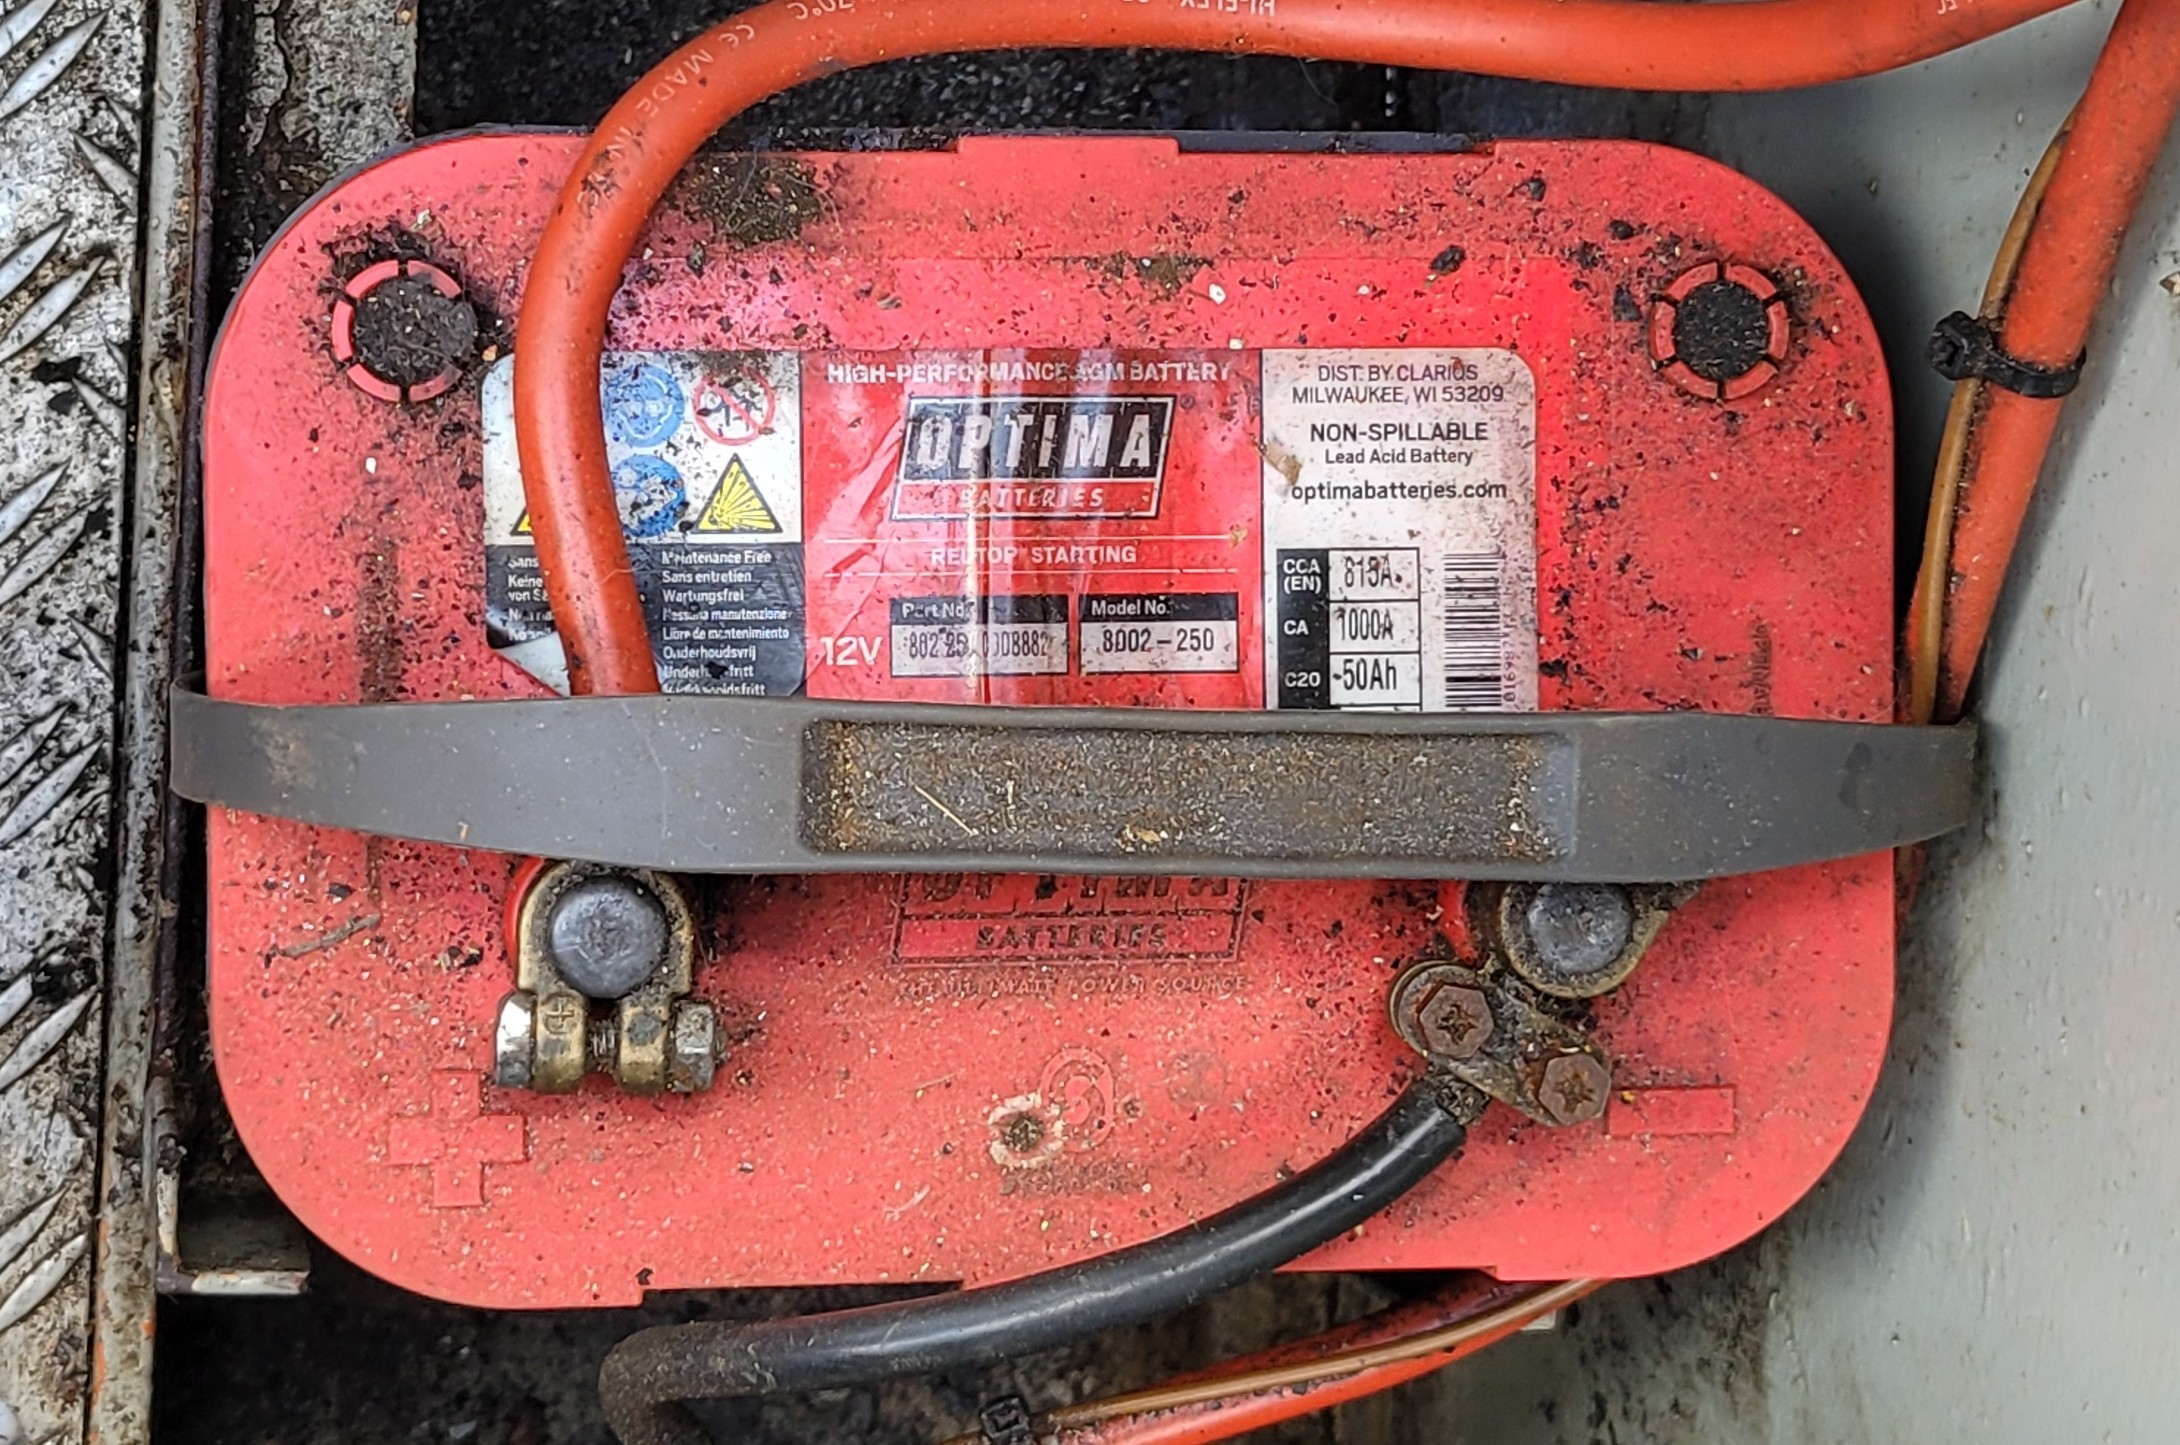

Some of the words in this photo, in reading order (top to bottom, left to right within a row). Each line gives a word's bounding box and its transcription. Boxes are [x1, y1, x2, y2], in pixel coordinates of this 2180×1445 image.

[636, 48, 715, 118] MADE
[827, 361, 1069, 384] HIGH-PERFORMANCE
[1129, 360, 1231, 382] BATTERY
[1367, 364, 1394, 381] BY
[1396, 363, 1479, 382] CLARIOS
[1292, 387, 1411, 405] MILWAUKEE,
[1413, 386, 1437, 403] WI
[1441, 385, 1505, 403] 53209
[916, 413, 1152, 471] OPTIMA
[1310, 422, 1489, 443] NON-SPILLABLE
[1325, 449, 1366, 465] Lead
[1370, 449, 1407, 464] Acid
[1410, 448, 1474, 467] Battery
[957, 487, 1105, 509] BATTERIES
[1291, 479, 1508, 505] optimabatteries.com
[744, 550, 773, 564] Free
[1031, 545, 1137, 564] STARTING
[1282, 558, 1322, 574] CCA
[508, 574, 544, 588] Keine
[662, 570, 693, 583] Sans
[1283, 576, 1322, 595] (EN)
[1091, 599, 1142, 618] Model
[1144, 599, 1172, 616] No.
[1283, 619, 1310, 635] CA
[1335, 607, 1394, 641] 1000A
[819, 636, 883, 667] 12V
[1284, 670, 1321, 688] C20
[1342, 657, 1397, 691] 50Ah
